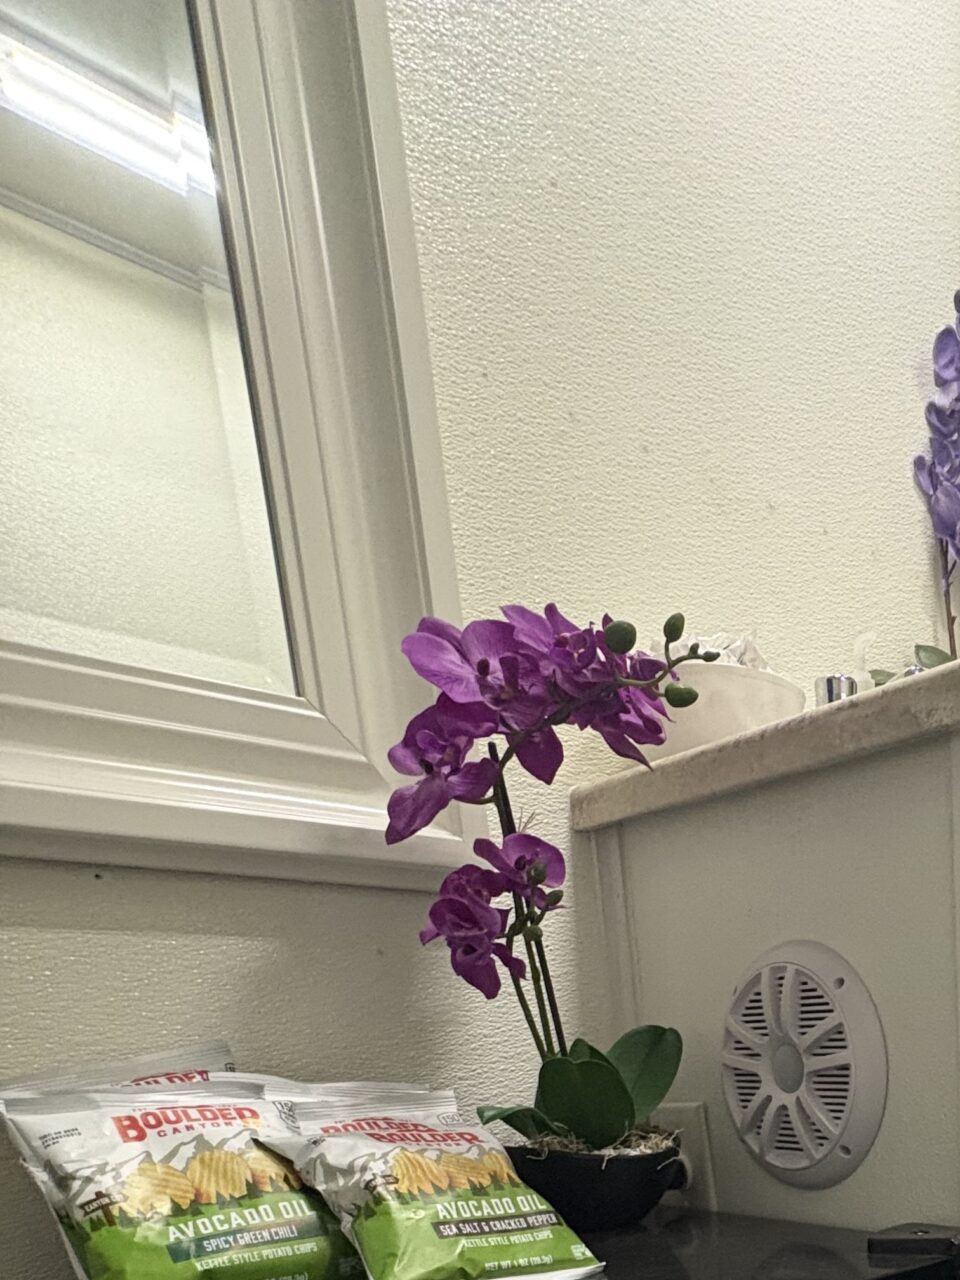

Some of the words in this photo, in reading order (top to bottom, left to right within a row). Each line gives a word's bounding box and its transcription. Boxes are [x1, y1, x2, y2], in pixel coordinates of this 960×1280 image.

[157, 1121, 234, 1139] CANYON
[365, 1131, 486, 1145] BOULDER
[436, 1197, 516, 1220] AVOCADO
[516, 1194, 548, 1212] OIL
[168, 1203, 276, 1242] AVOCADO
[278, 1199, 317, 1219] OIL
[439, 1223, 460, 1236] SEA
[460, 1221, 481, 1235] SALT
[489, 1218, 528, 1232] CRACKED
[528, 1213, 558, 1227] PEPPER
[203, 1236, 236, 1252] SPICY
[236, 1231, 271, 1246] GREEN
[271, 1225, 299, 1241] CHILI
[490, 1235, 510, 1247] STYLE
[510, 1233, 534, 1245] POTATO
[534, 1230, 554, 1242] CHIPS
[232, 1249, 263, 1265] STYLE
[262, 1245, 294, 1261] POTATO
[294, 1242, 319, 1255] CHIPS
